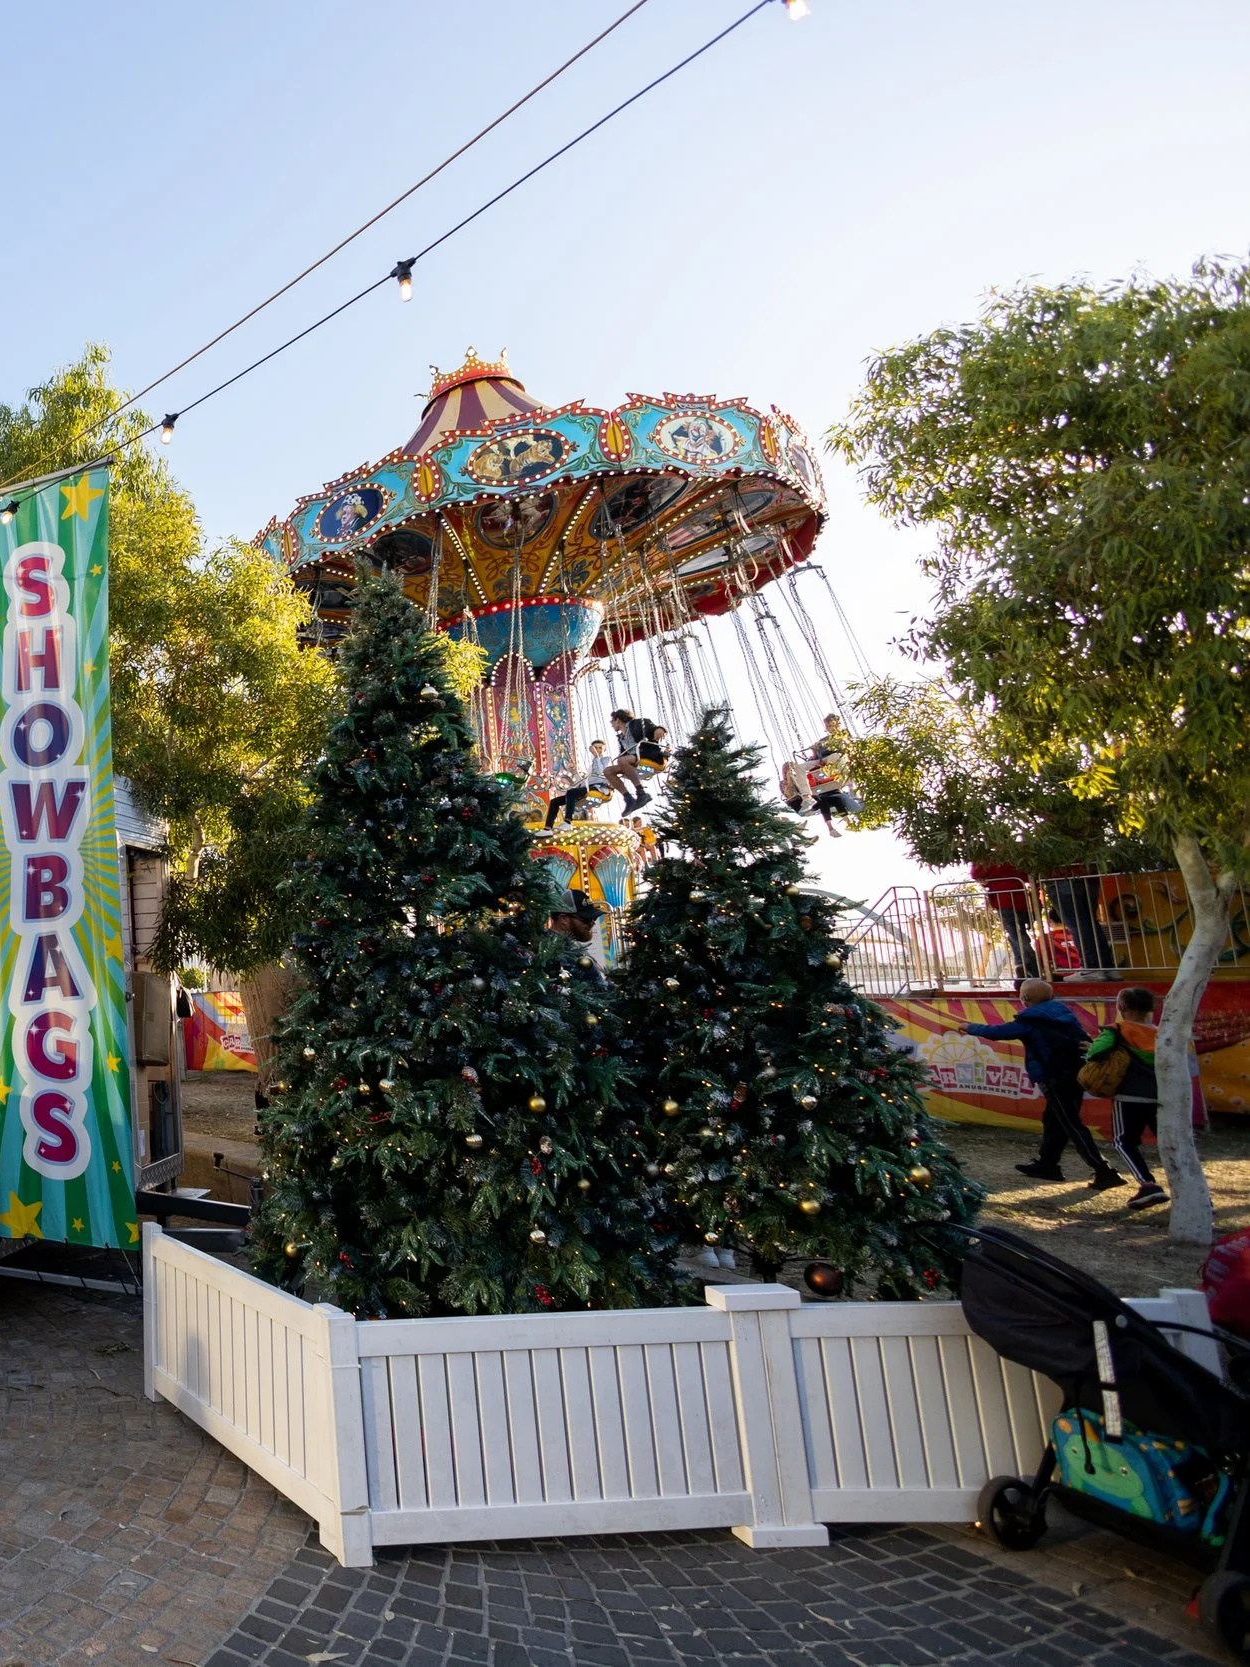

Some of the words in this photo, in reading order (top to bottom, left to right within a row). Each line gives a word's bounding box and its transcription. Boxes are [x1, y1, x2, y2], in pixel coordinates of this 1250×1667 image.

[6, 552, 90, 1167] SHOWBAGS
[924, 1062, 1035, 1095] ARNIVAL
[958, 1084, 1019, 1096] AMUSEMENTS
